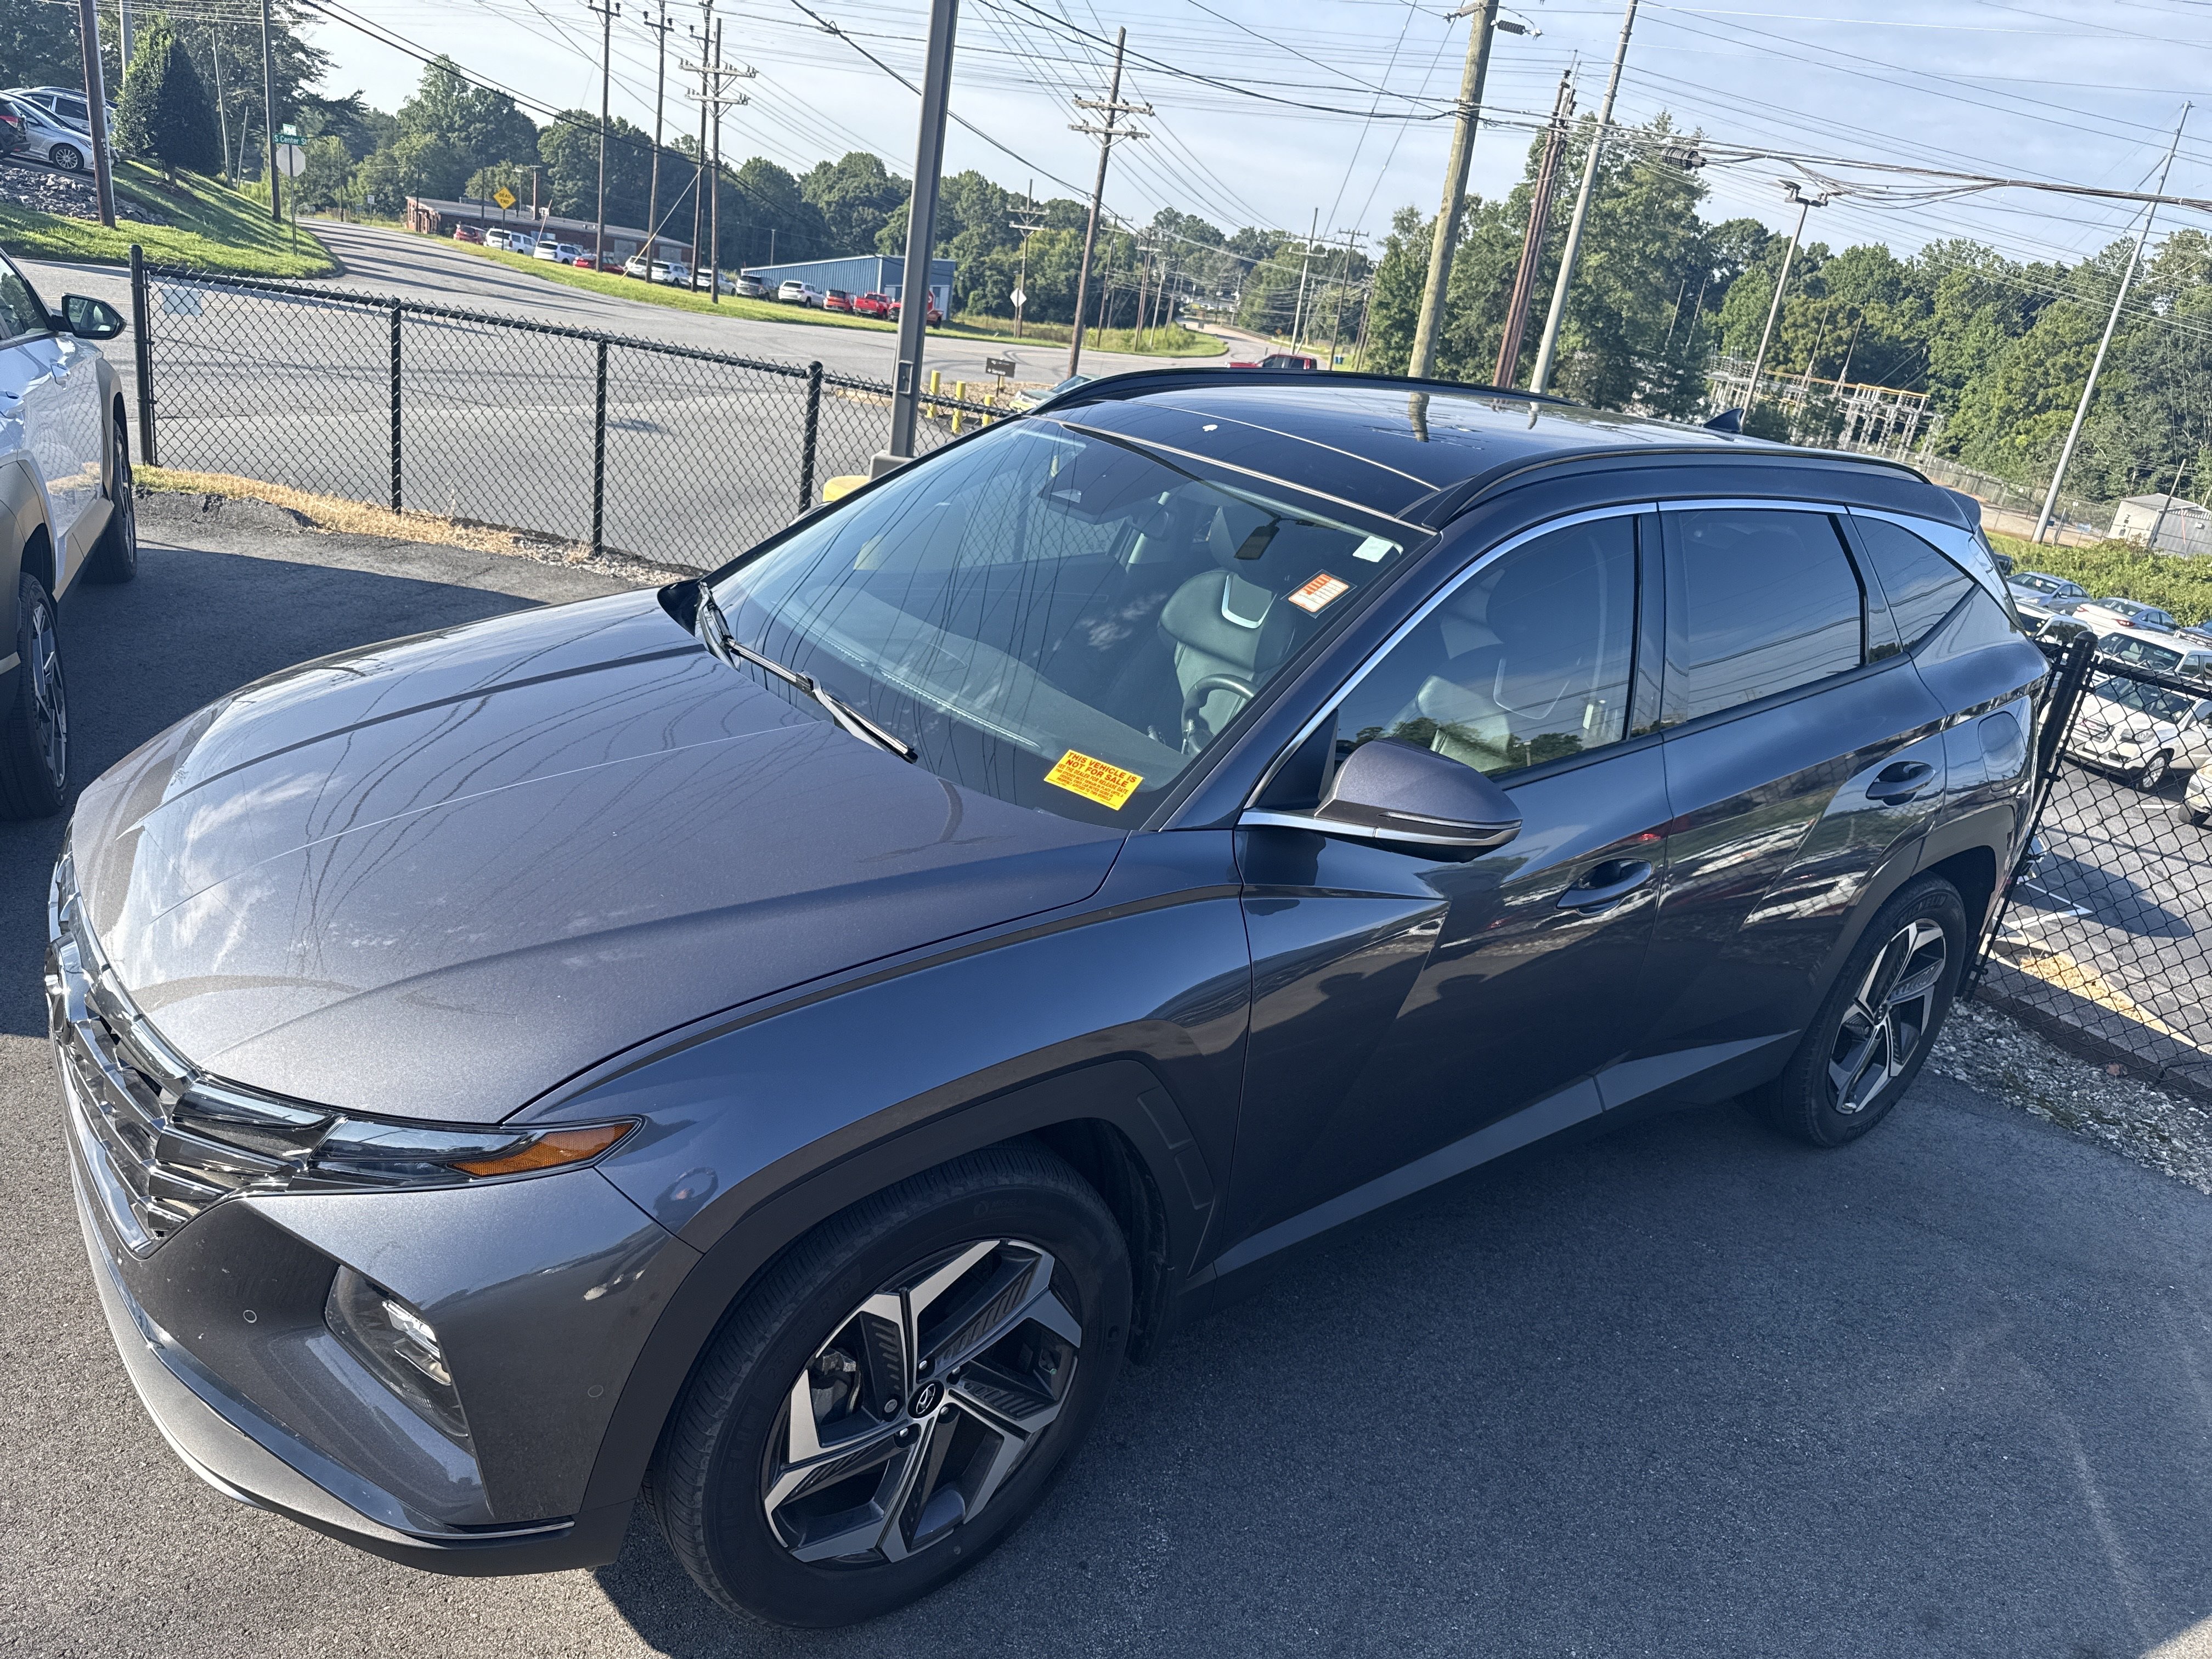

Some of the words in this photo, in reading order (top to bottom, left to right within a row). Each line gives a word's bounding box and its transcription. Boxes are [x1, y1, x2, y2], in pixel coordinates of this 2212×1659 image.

[280, 136, 300, 144] Center
[1065, 759, 1085, 769] NOT
[1085, 766, 1104, 777] FOR
[1104, 774, 1128, 787] SALE
[1068, 752, 1087, 763] THIS
[1088, 760, 1126, 778] VEHICLE
[1073, 769, 1090, 778] DEALER
[1098, 779, 1118, 789] RELEASE
[1898, 895, 1946, 928] MICHELIN
